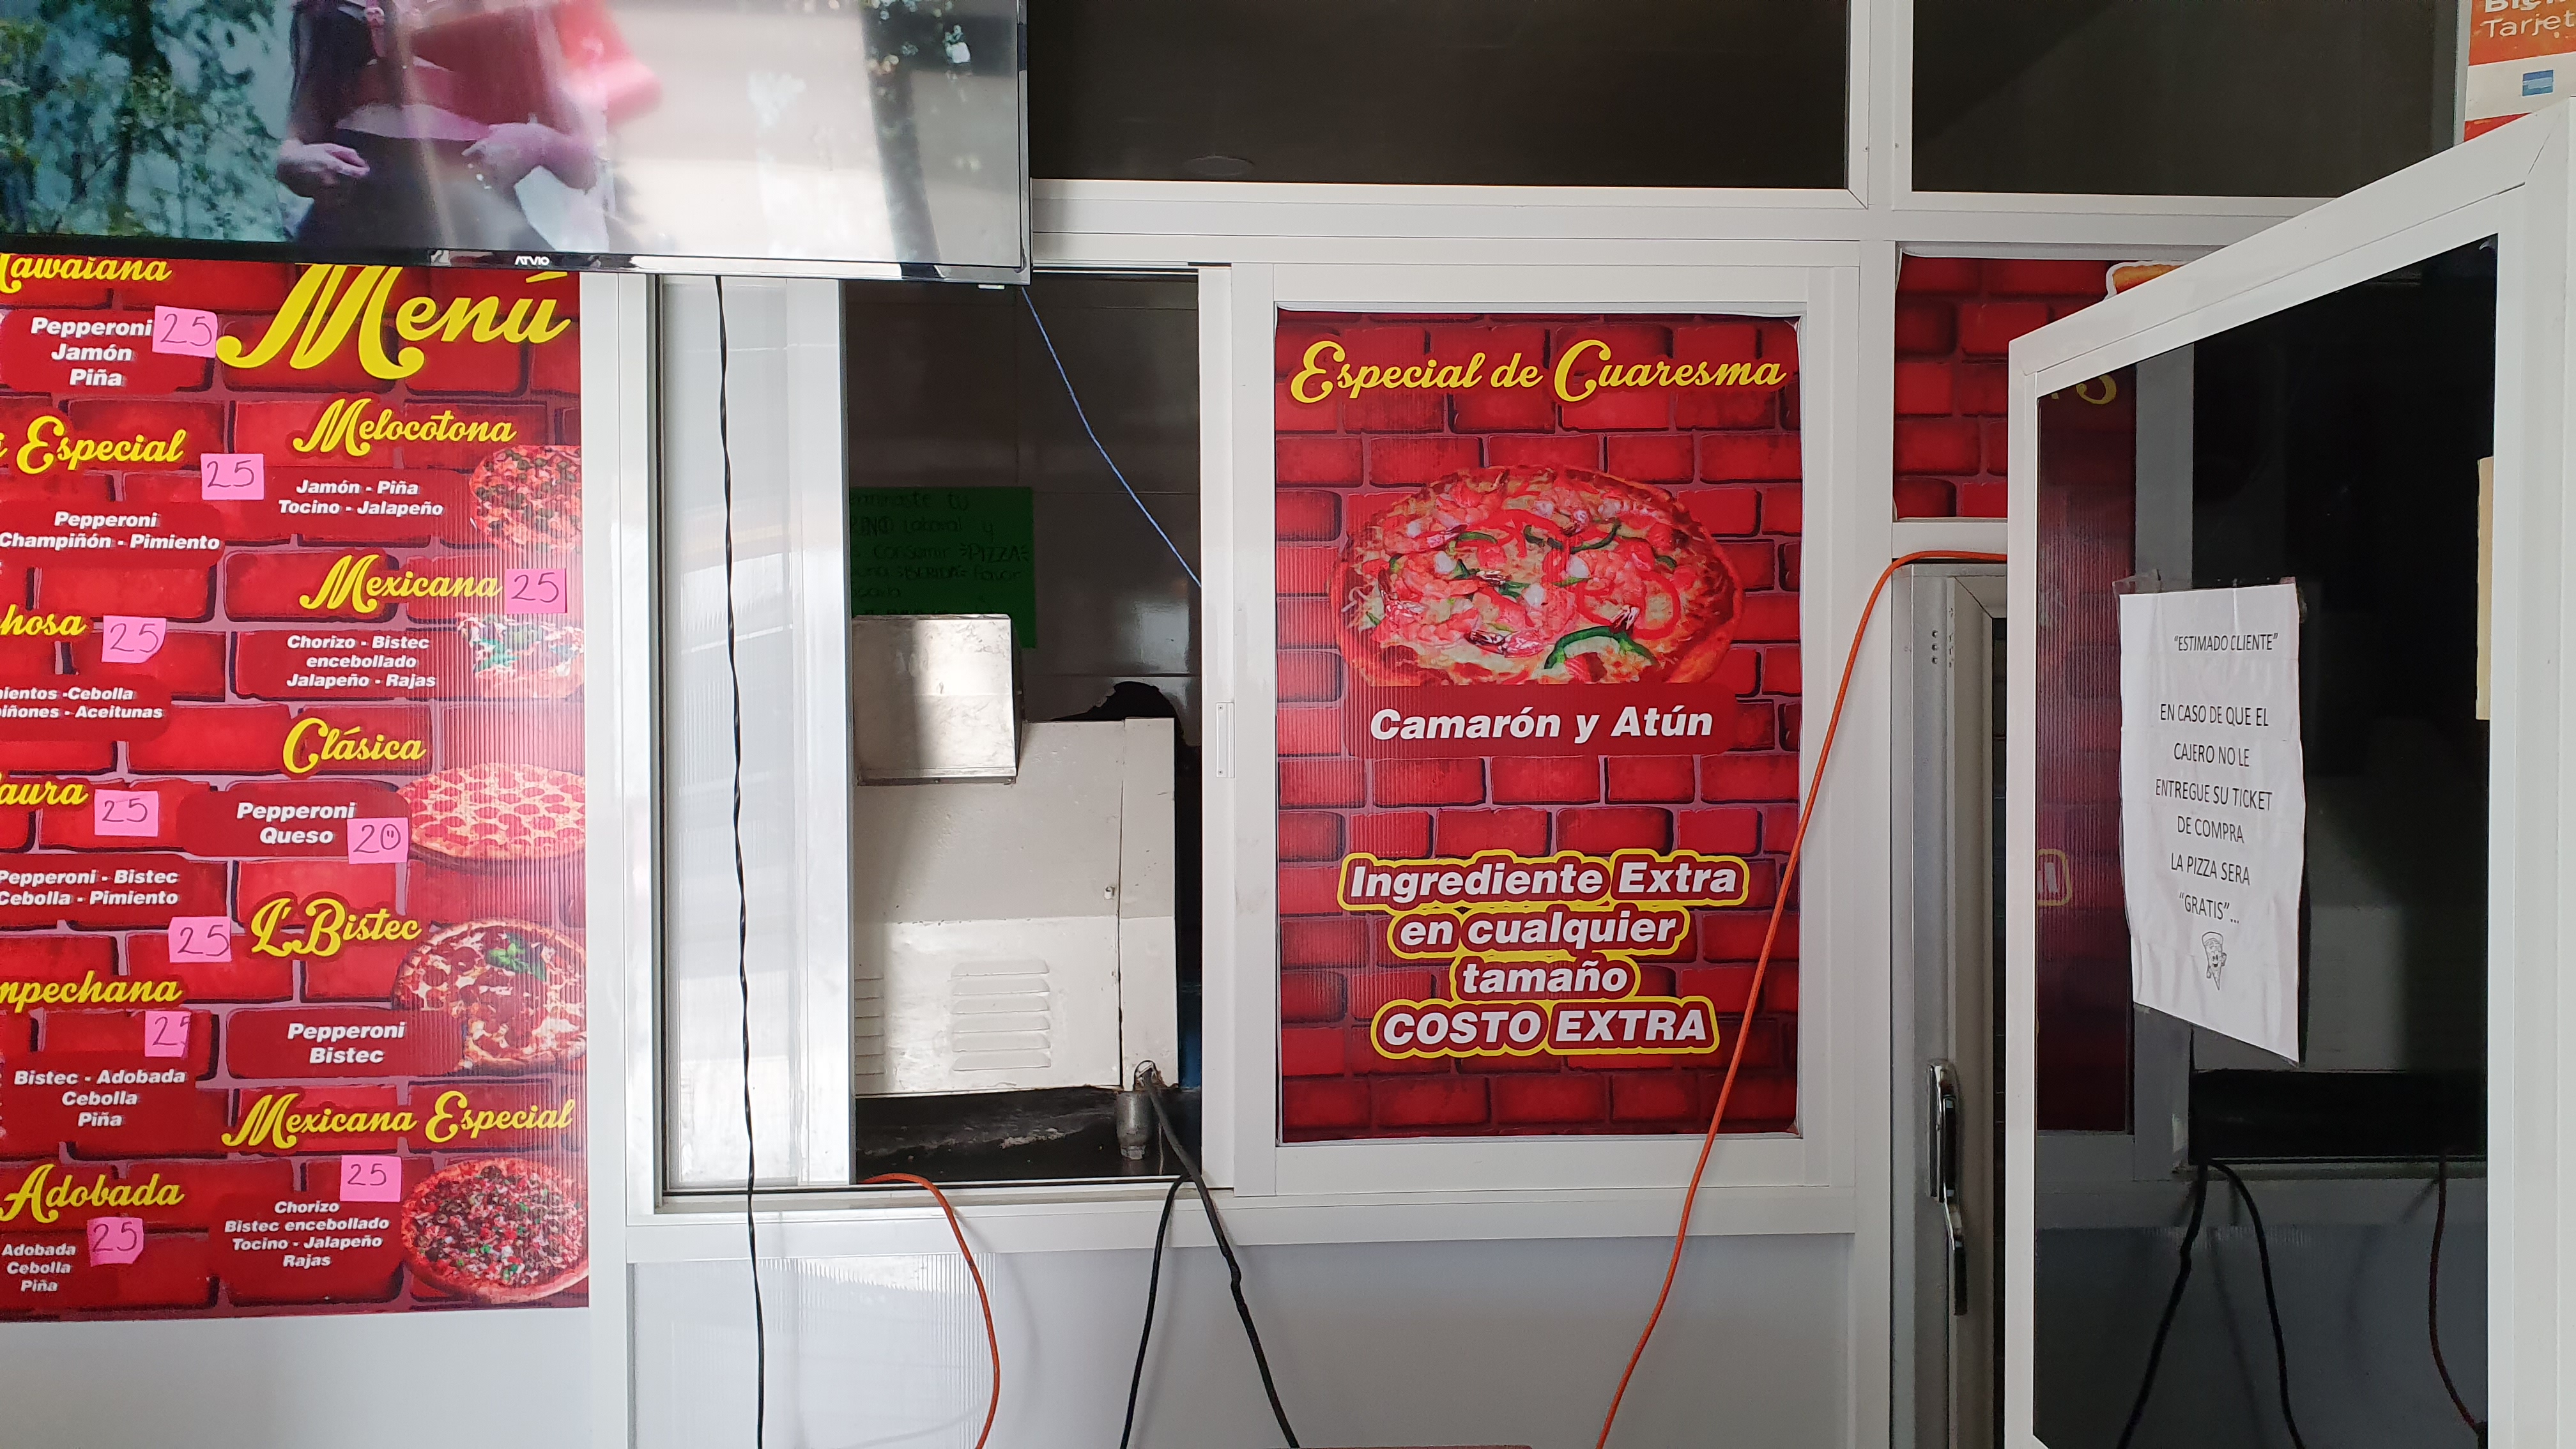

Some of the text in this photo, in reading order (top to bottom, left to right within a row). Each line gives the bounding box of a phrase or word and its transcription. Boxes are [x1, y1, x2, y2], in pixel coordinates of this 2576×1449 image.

[515, 256, 549, 266] ATVIO
[31, 318, 153, 338] Pepperoni
[161, 314, 211, 346] 25
[217, 264, 571, 379] Menú
[52, 344, 132, 361] Jamón
[70, 369, 123, 386] Piña
[1291, 341, 1785, 402] Especial de Cuaresma
[293, 399, 516, 456] Melocotona
[17, 417, 186, 473] Especial
[207, 460, 254, 487] 25
[296, 480, 361, 493] Jamón
[378, 481, 418, 494] Piña
[279, 500, 341, 514] Tocino
[357, 501, 443, 517] Jalapeño
[55, 512, 157, 529] Pepperoni
[0, 533, 112, 551] Champiñón
[130, 534, 220, 549] Pimiento
[299, 554, 502, 613] Mexicana
[512, 572, 558, 602] 25
[111, 624, 162, 654] 25
[288, 635, 356, 648] Chorizo
[372, 636, 429, 649] Bistec
[307, 655, 418, 668] encebollado
[287, 674, 370, 689] Jalapeño
[386, 674, 436, 689] Rajas
[0, 705, 59, 717] iñones
[75, 705, 162, 718] Aceitunas
[2161, 704, 2268, 726] EN CASO DE QUE EL
[1371, 705, 1712, 743] Camarón y Atún
[284, 719, 425, 773] Clásica
[2174, 743, 2249, 767] CAJERO NO LE
[0, 774, 88, 804] aura
[2156, 779, 2272, 810] ENTREGUE SU TICKET
[102, 798, 147, 822] 25
[237, 802, 356, 822] Pepperoni
[260, 827, 335, 844] Queso
[2178, 816, 2244, 843] DE COMPRA
[0, 870, 96, 887] Pepperoni
[114, 870, 178, 884] Bistec
[2172, 853, 2250, 885] LA PIZZA SERA
[1351, 862, 1736, 903] Ingrediente Extra
[0, 891, 71, 905] Cebolla
[90, 891, 178, 904] Pimiento
[1401, 911, 1676, 949] en cualquier
[178, 925, 229, 956] 25
[1463, 961, 1627, 993] tamaño
[288, 1022, 406, 1042] Pepperoni
[1384, 1010, 1706, 1045] COSTO EXTRA
[310, 1047, 384, 1063] Bistec
[15, 1071, 78, 1084] Bistec
[97, 1070, 185, 1084] Adobada
[63, 1091, 137, 1105] Cebolla
[79, 1112, 122, 1126] Piña
[222, 1091, 576, 1148] Mexicana Especial
[348, 1163, 386, 1185] 25
[0, 1165, 183, 1223] Adobada
[275, 1201, 339, 1213] Chorizo
[225, 1218, 389, 1232] Bistec encebollado
[91, 1222, 137, 1252] 25
[233, 1238, 288, 1250] Tocino
[304, 1235, 383, 1250] Jalapeño
[2, 1244, 75, 1255] Adobada
[8, 1262, 71, 1274] Cebolla
[284, 1255, 330, 1269] Rajas
[21, 1280, 57, 1291] Piña
